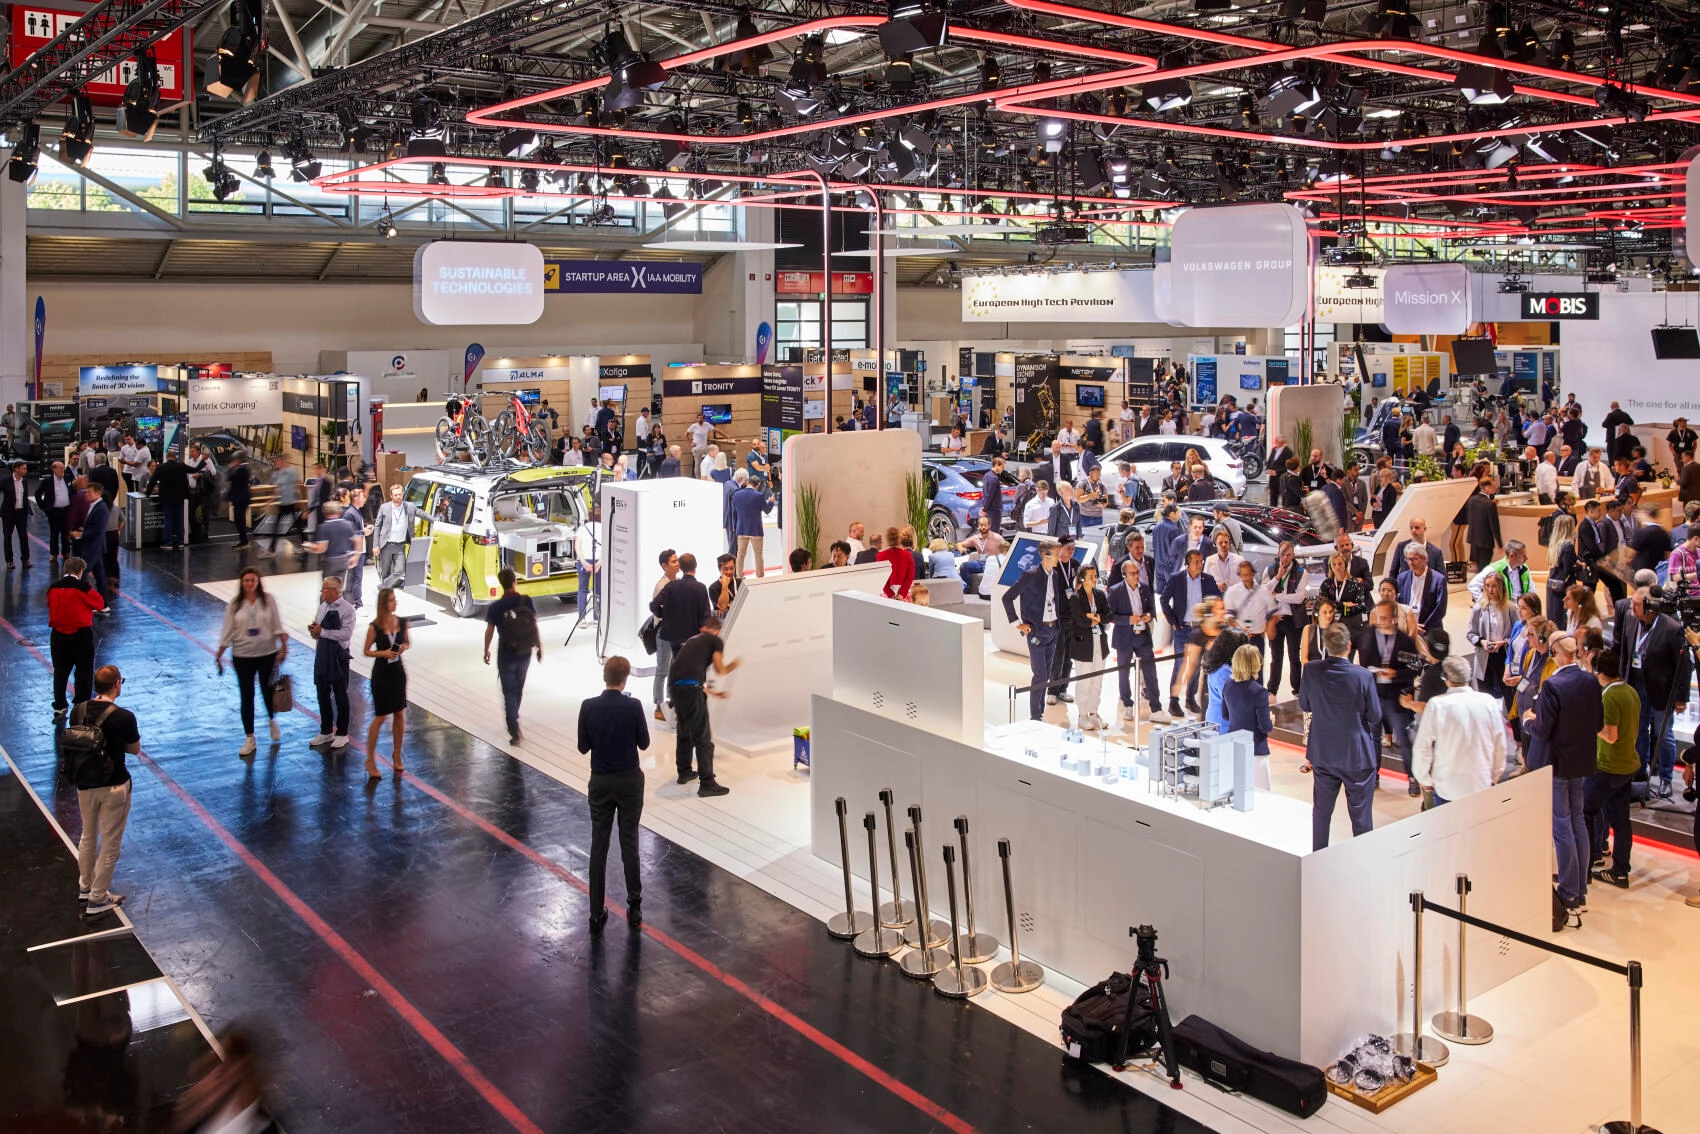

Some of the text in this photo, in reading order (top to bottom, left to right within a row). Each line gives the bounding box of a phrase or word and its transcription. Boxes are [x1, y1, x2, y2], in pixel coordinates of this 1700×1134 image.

[1183, 259, 1292, 272] VOLKSWAGEN GROUP
[439, 267, 526, 280] SUSTAINABLE
[565, 272, 605, 281] STARTUP
[606, 272, 630, 281] AREA
[647, 273, 661, 282] IAA
[662, 274, 696, 282] MOBILITY
[432, 282, 534, 296] TECHNOLOGIES
[1395, 290, 1462, 305] Mission X
[973, 299, 1020, 308] European
[1021, 298, 1043, 308] High
[1044, 298, 1068, 306] Tech
[1529, 297, 1587, 315] MOBIS
[822, 352, 849, 363] ecited
[1016, 363, 1047, 372] DYNAMISCH
[96, 374, 129, 382] Redefining
[519, 371, 544, 379] ALMA
[92, 383, 109, 391] limits
[109, 383, 117, 391] of
[704, 382, 735, 391] TRONITY
[192, 401, 218, 411] Matrix
[1628, 399, 1644, 408] The
[1645, 401, 1663, 409] one
[1664, 400, 1677, 409] for
[1679, 401, 1690, 410] all
[673, 499, 686, 508] Elli
